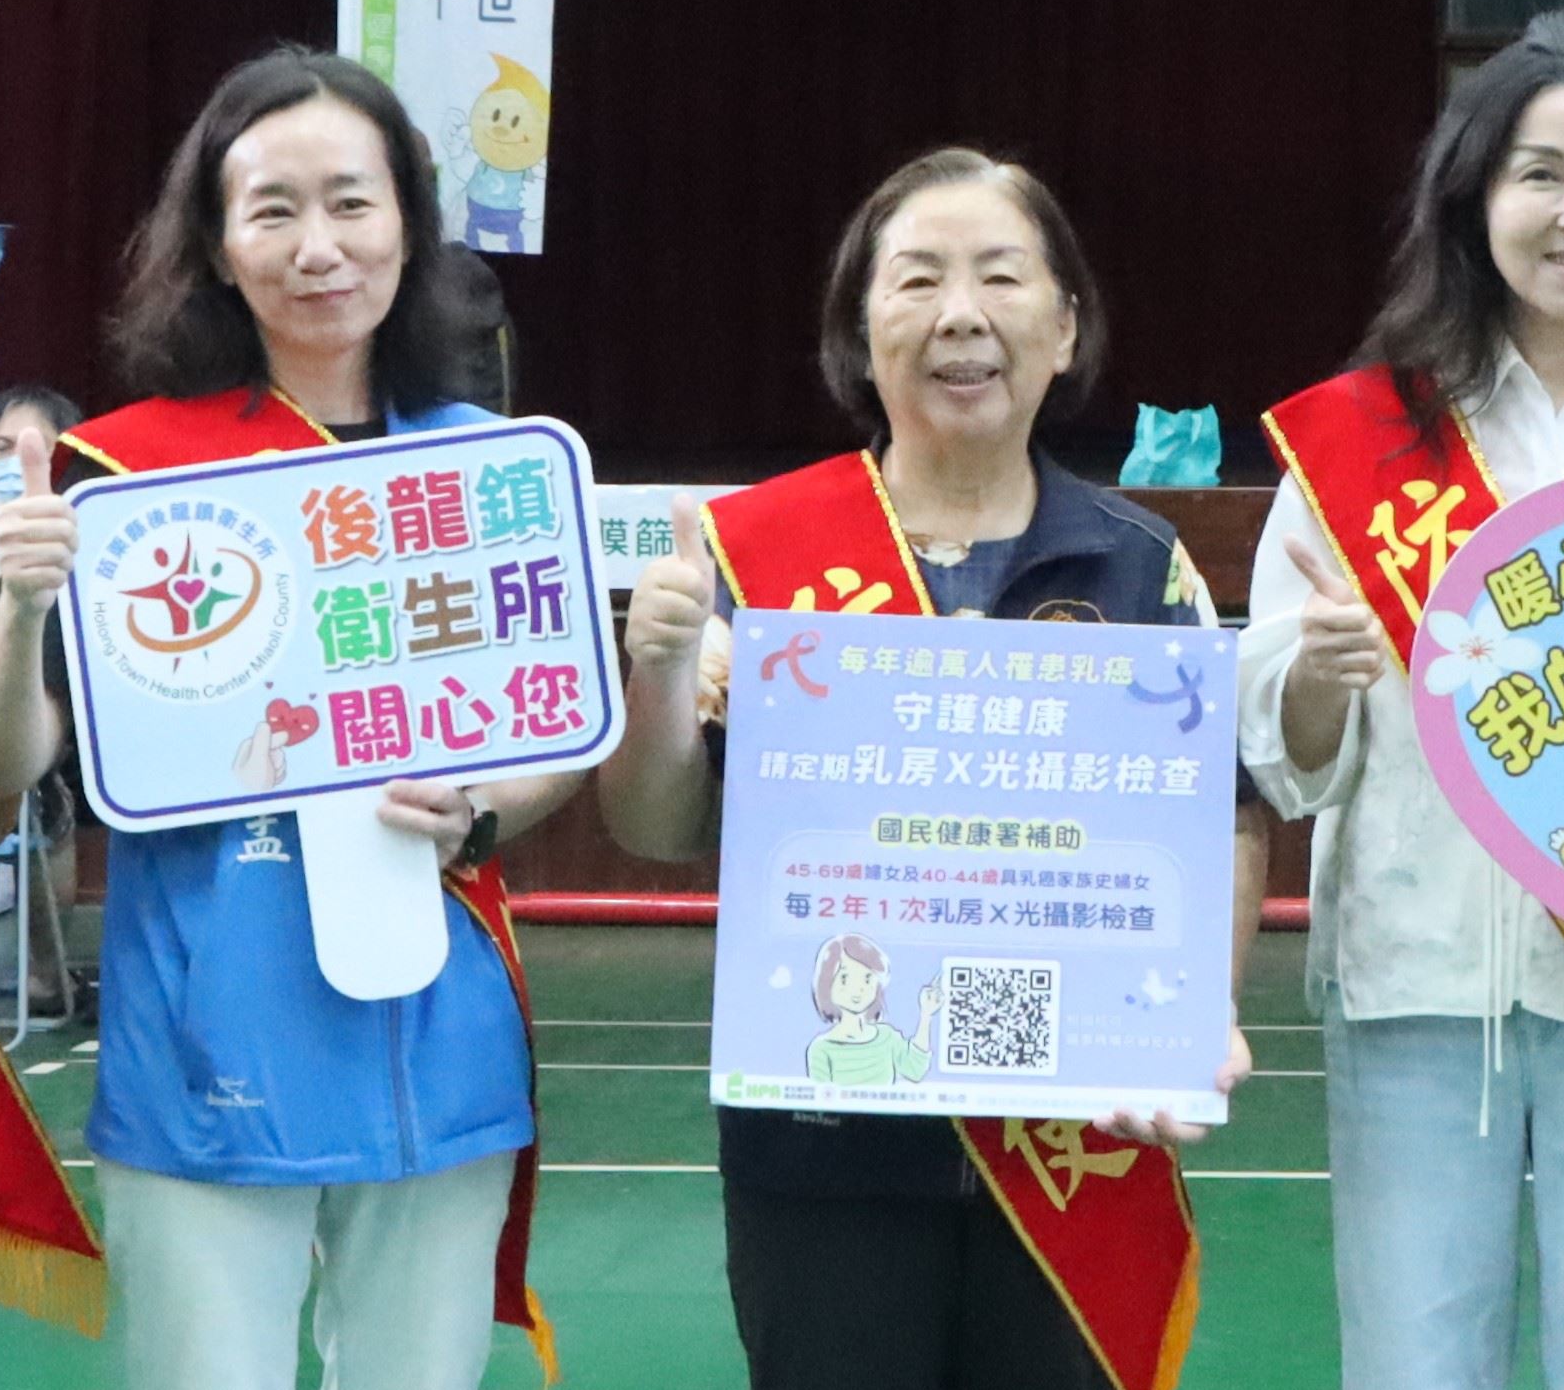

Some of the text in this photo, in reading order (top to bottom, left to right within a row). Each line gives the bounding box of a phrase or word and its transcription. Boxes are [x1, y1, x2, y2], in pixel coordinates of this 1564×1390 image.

[299, 456, 559, 567] 後龍鎮
[114, 652, 149, 688] Town
[149, 680, 200, 701] Health
[203, 670, 254, 699] Center
[249, 630, 284, 673] Miaoli
[273, 572, 290, 627] County
[310, 555, 569, 669] 衛生所
[326, 662, 589, 768] 關心您
[892, 691, 1070, 738] 守護健康
[759, 743, 1202, 796] 請定期乳房X光攝影檢查
[877, 817, 1082, 851] 國民健康署補助
